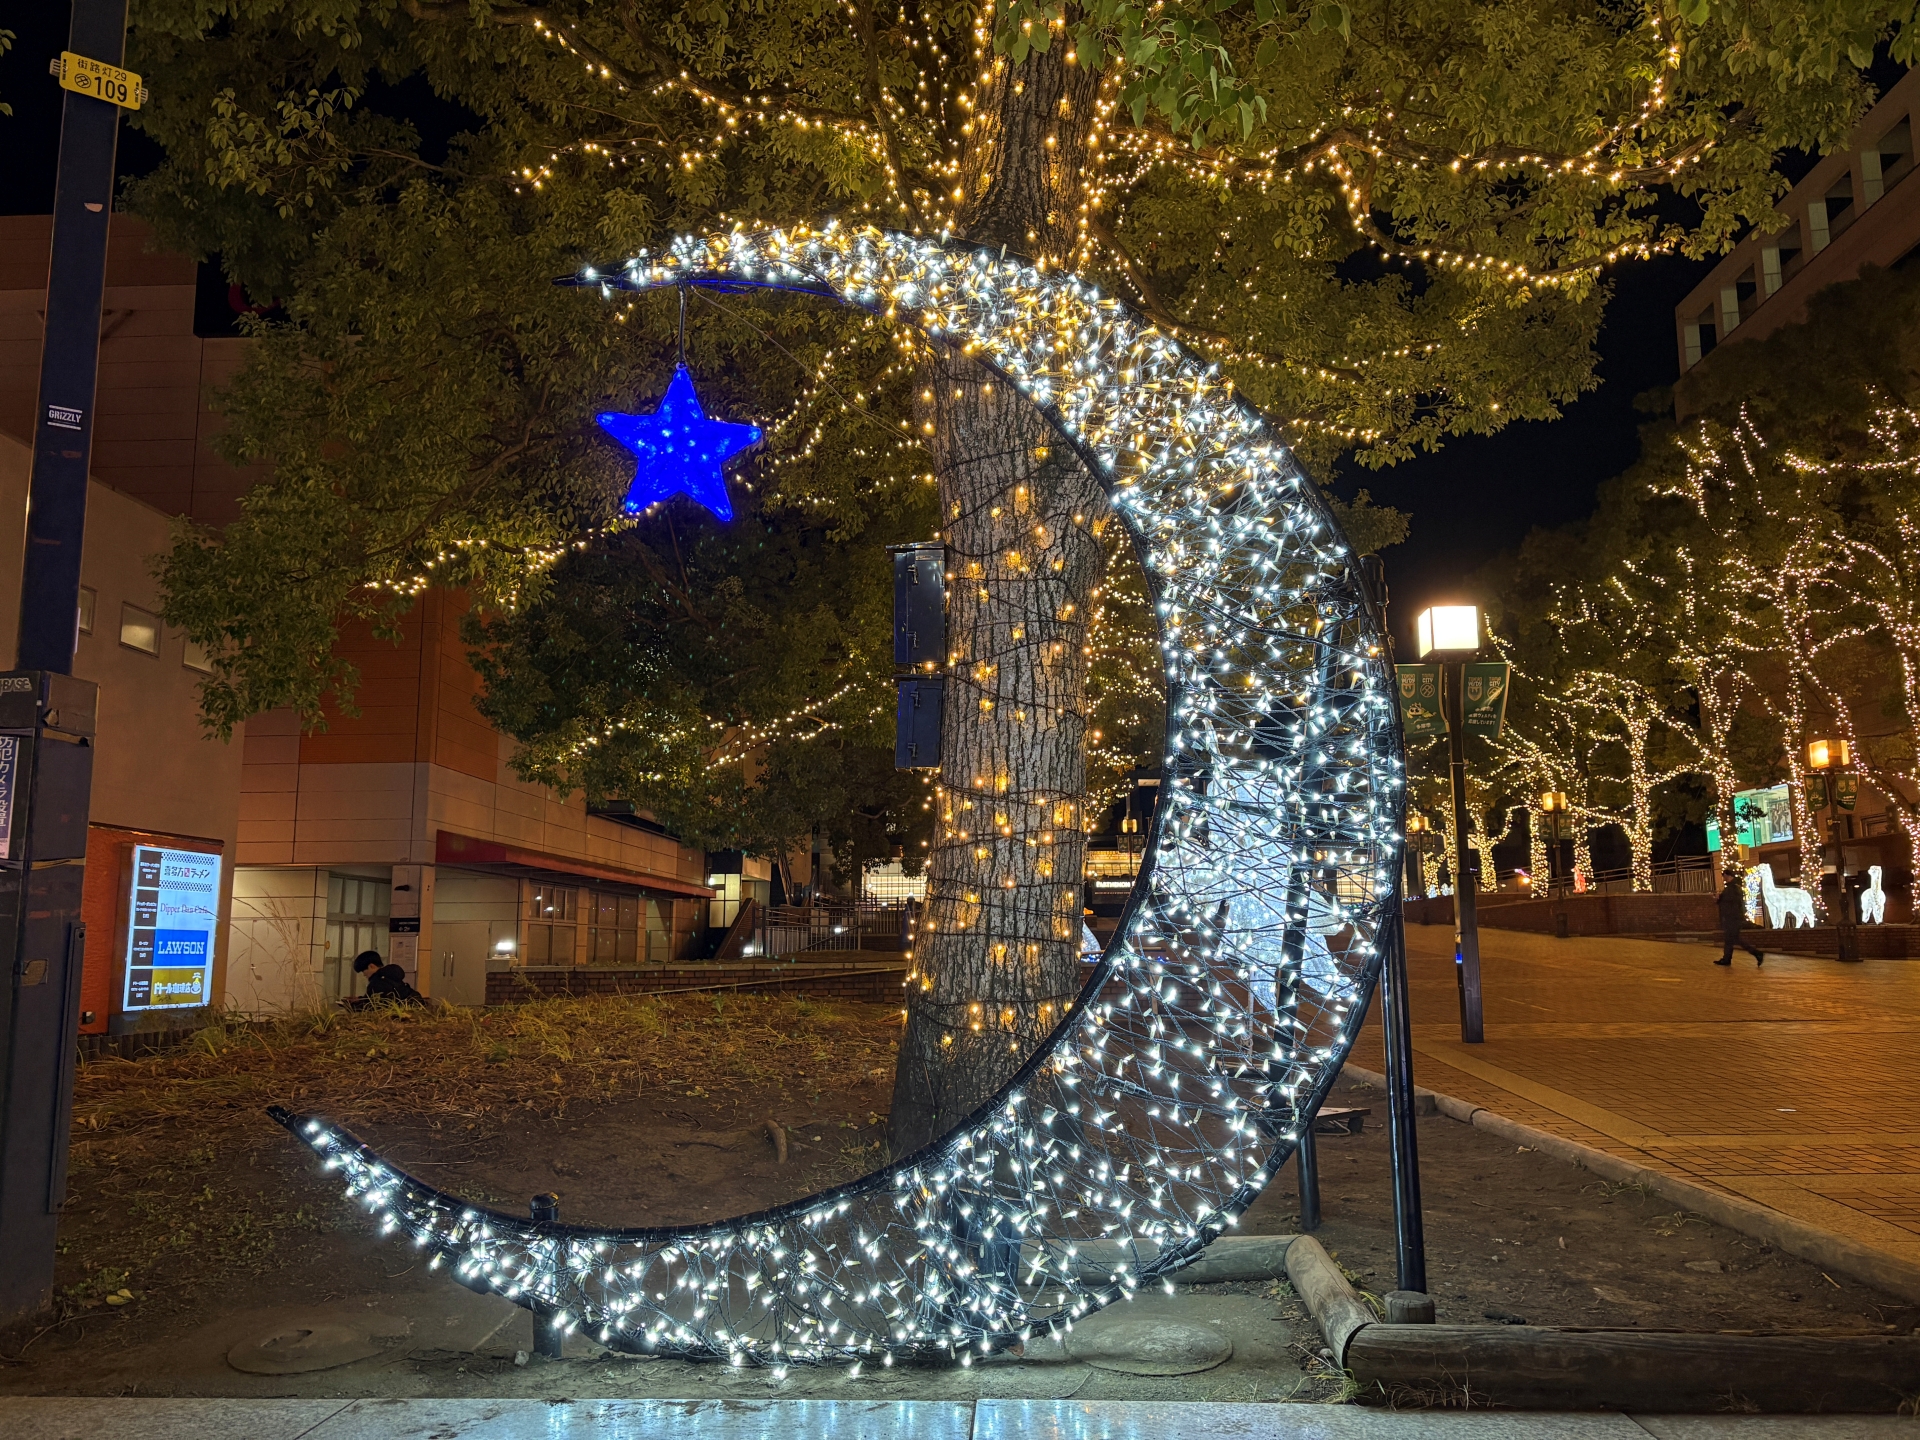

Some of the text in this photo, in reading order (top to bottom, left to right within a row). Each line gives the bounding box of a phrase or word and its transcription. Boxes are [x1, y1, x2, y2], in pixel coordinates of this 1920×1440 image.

[94, 76, 127, 103] 109
[48, 409, 82, 423] GRIZZLY
[157, 941, 204, 954] LAWSON
